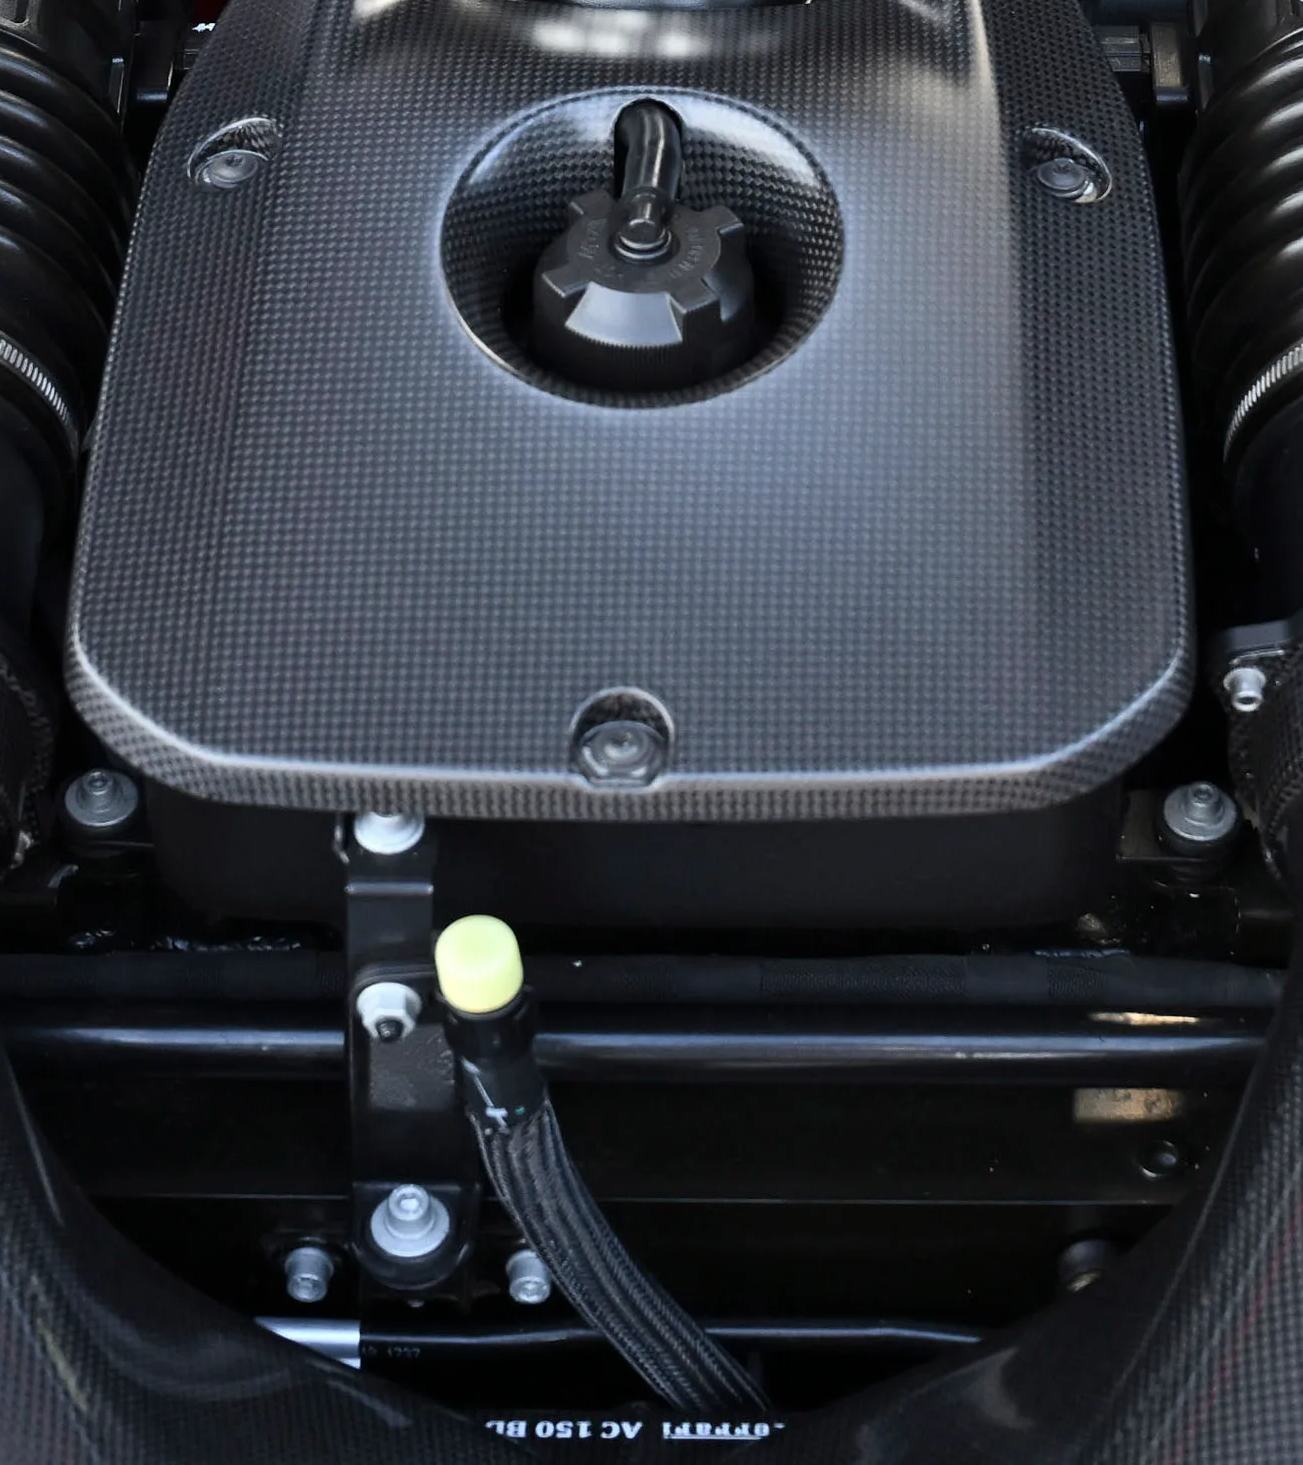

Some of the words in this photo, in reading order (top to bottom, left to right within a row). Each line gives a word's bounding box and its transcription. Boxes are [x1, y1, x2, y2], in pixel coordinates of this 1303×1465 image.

[535, 1421, 592, 1438] 150
[601, 1421, 643, 1439] AC
[662, 1421, 785, 1440] errari
